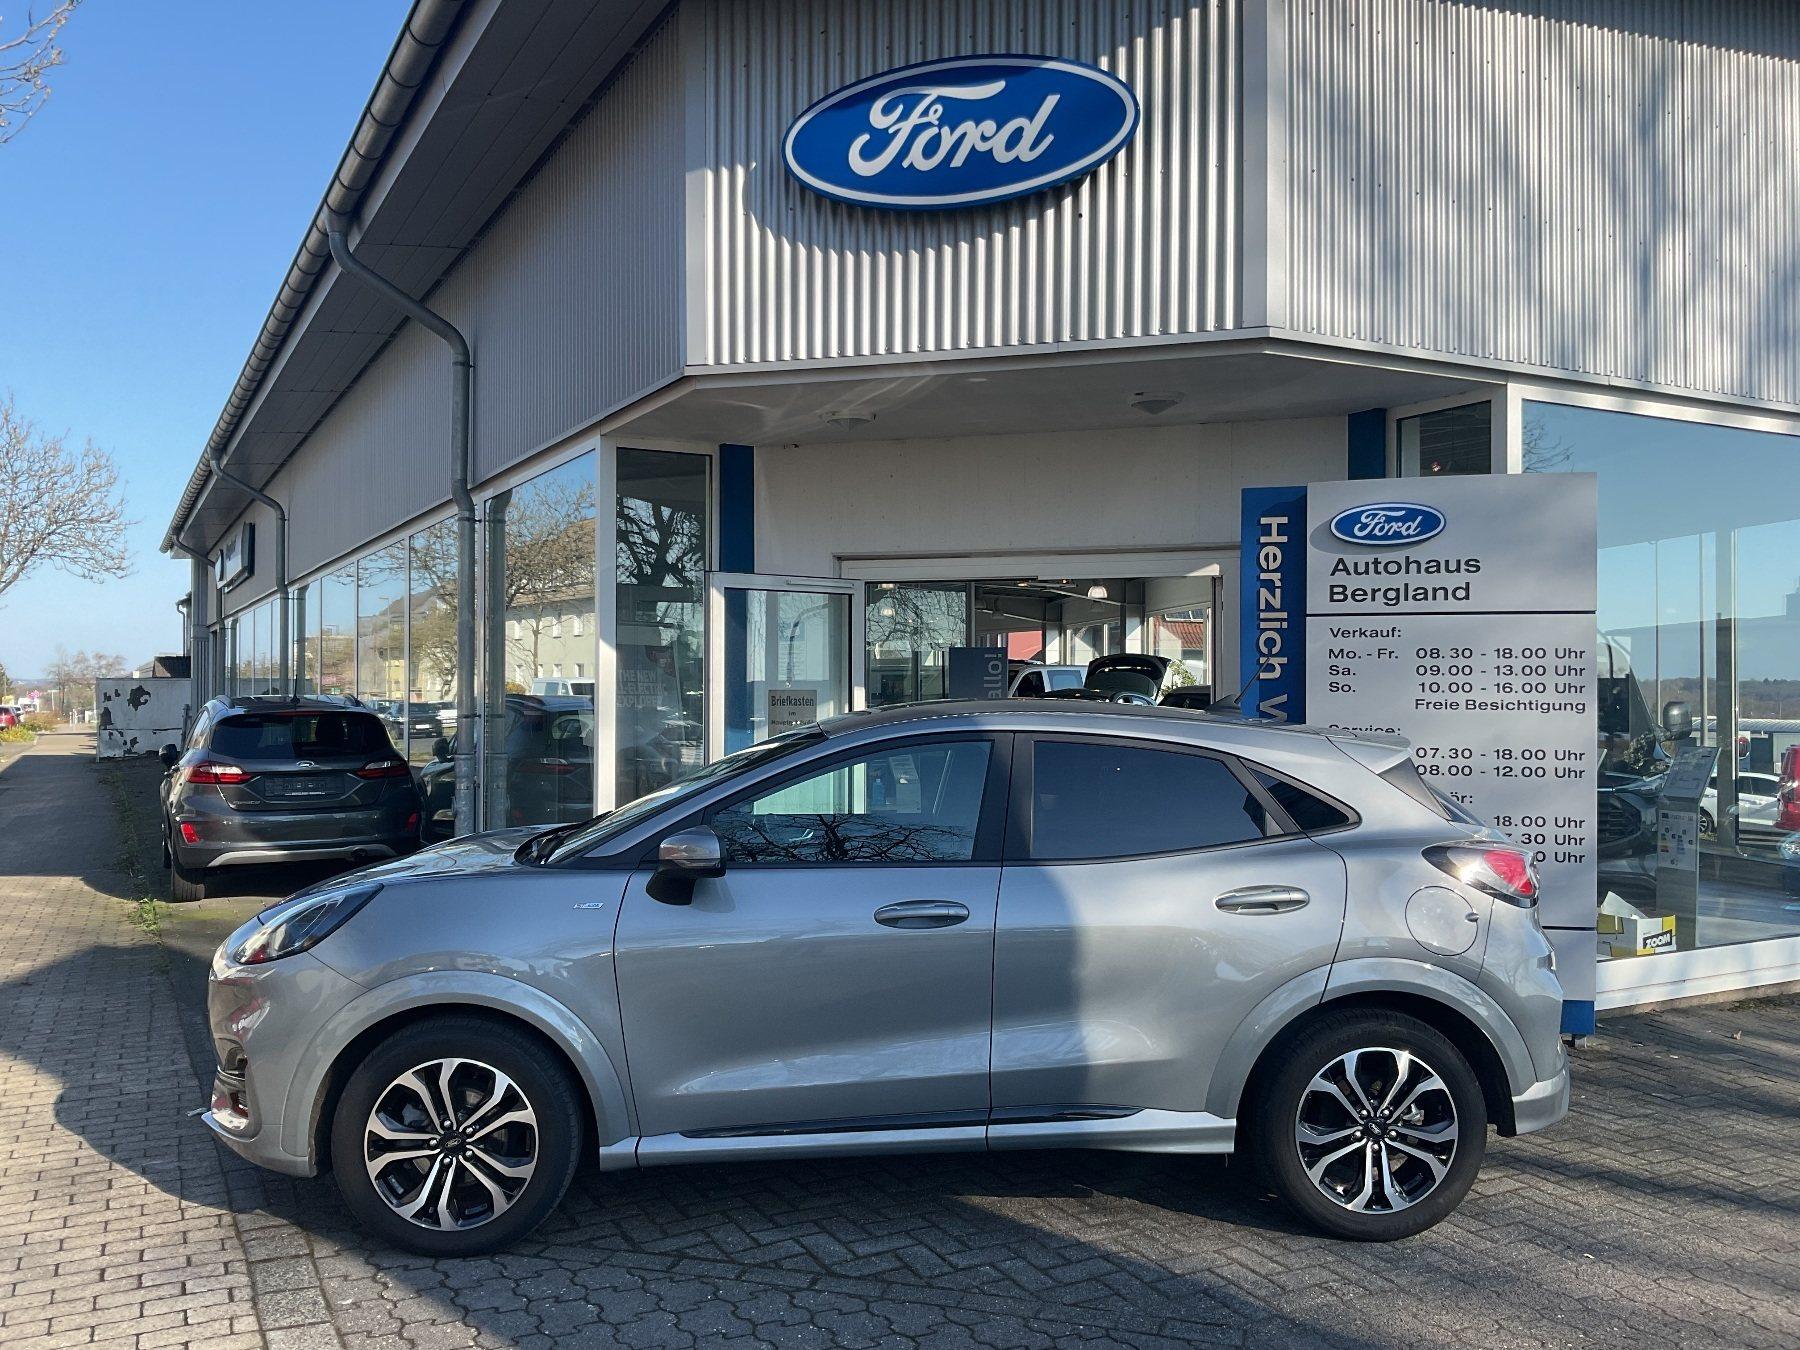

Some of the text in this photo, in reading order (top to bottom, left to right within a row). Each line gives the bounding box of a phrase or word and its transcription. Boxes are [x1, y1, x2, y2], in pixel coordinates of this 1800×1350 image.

[848, 80, 1061, 177] Ford
[1353, 509, 1421, 537] Ford
[1329, 555, 1481, 577] Autohaus
[1258, 516, 1289, 680] Herzlich
[1328, 581, 1471, 607] Bergland
[1328, 626, 1402, 639] Verkauf:
[1328, 648, 1362, 660] Mo.
[1377, 647, 1399, 660] Fr.
[1415, 647, 1473, 660] 08.30
[1493, 647, 1547, 660] 18.00
[1554, 647, 1586, 660] Uhr
[1328, 664, 1356, 677] Sa.
[1415, 664, 1473, 677] 09.00
[1493, 664, 1547, 677] 13.00
[1554, 664, 1586, 677] Uhr
[1328, 681, 1356, 693] So.
[1418, 681, 1473, 694] 10.00
[1493, 681, 1547, 694] 16.00
[1554, 682, 1586, 694] Uhr
[771, 695, 815, 706] Briefkasten
[1414, 698, 1586, 714] Freie Besichtigung
[1415, 746, 1473, 760] 07.30
[1493, 748, 1547, 761] 18.00
[1554, 749, 1586, 762] Uhr
[1416, 764, 1473, 777] 08.00
[1493, 765, 1547, 778] 12.00
[1554, 766, 1586, 779] Uhr
[1493, 815, 1586, 829] 18.00 Uhr
[1554, 833, 1586, 846] Uhr
[1554, 851, 1586, 864] Uhr
[1645, 932, 1672, 948] ZOOM
